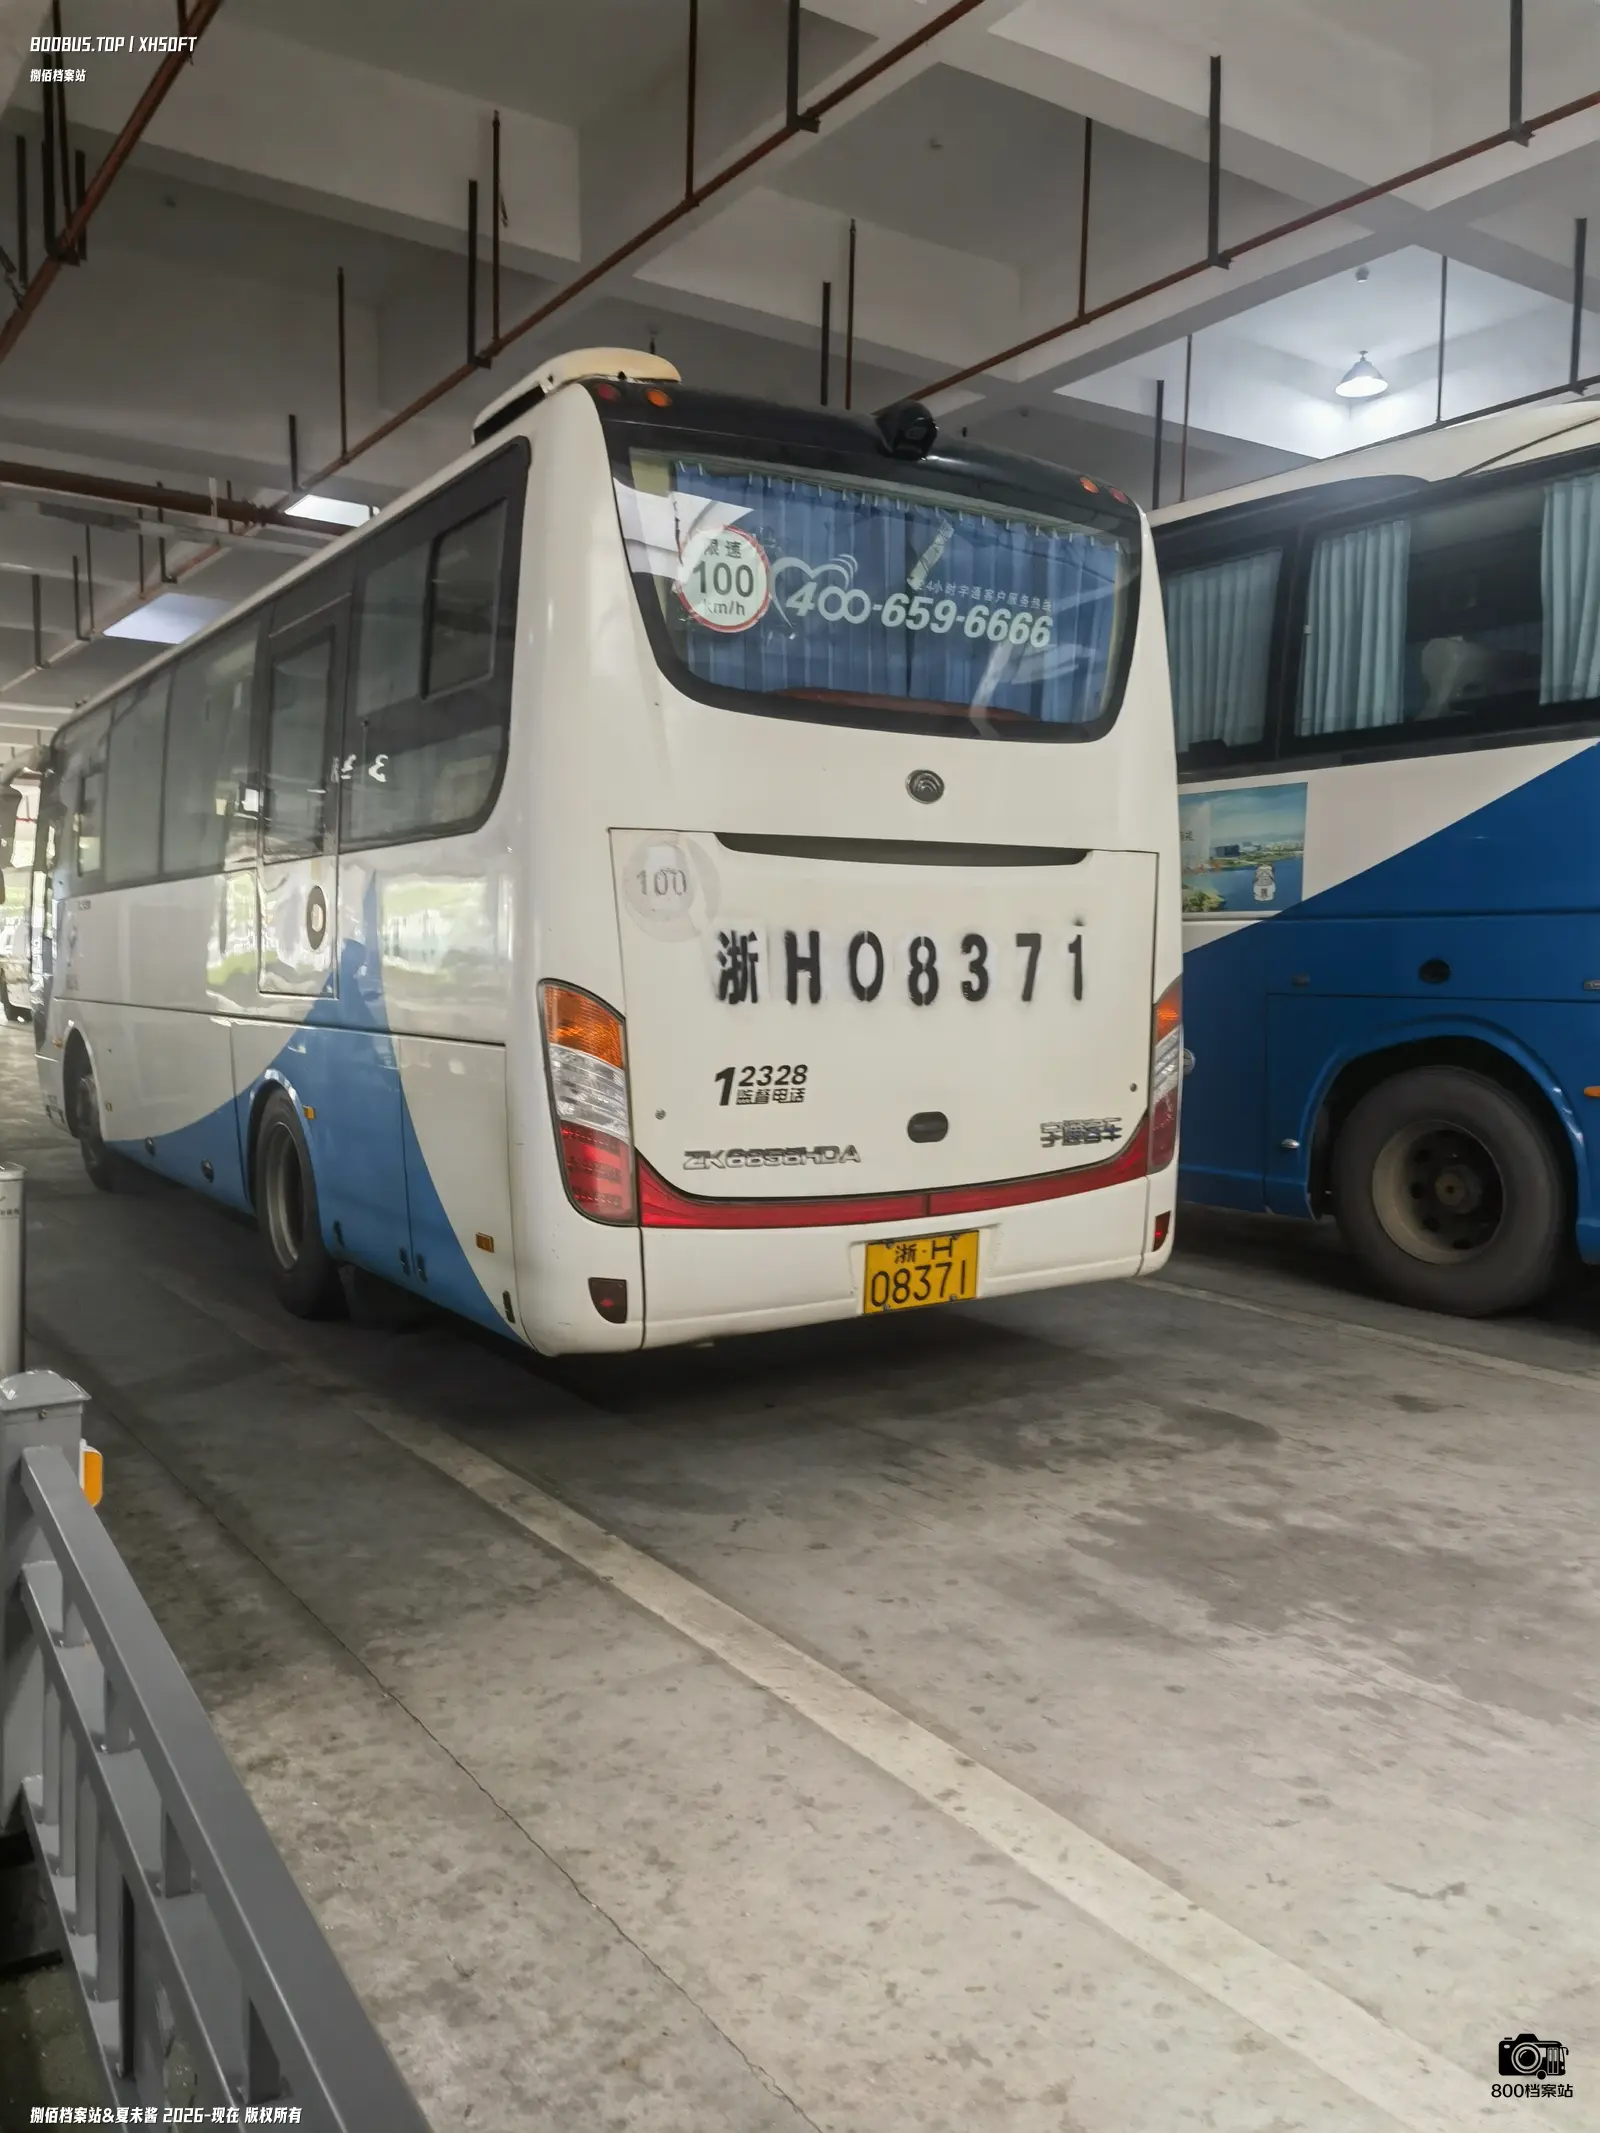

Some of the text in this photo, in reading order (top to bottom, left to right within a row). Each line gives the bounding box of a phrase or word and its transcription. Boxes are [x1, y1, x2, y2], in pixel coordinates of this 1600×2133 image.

[692, 560, 754, 598] 100
[703, 599, 746, 616] km/h
[785, 582, 1054, 648] 400-659-6666
[717, 930, 1083, 1006] 浙H08371
[714, 1064, 808, 1106] 12328
[736, 1087, 806, 1105] 监督电话
[1040, 1117, 1122, 1148] 宇通客车
[871, 1260, 966, 1307] 08371
